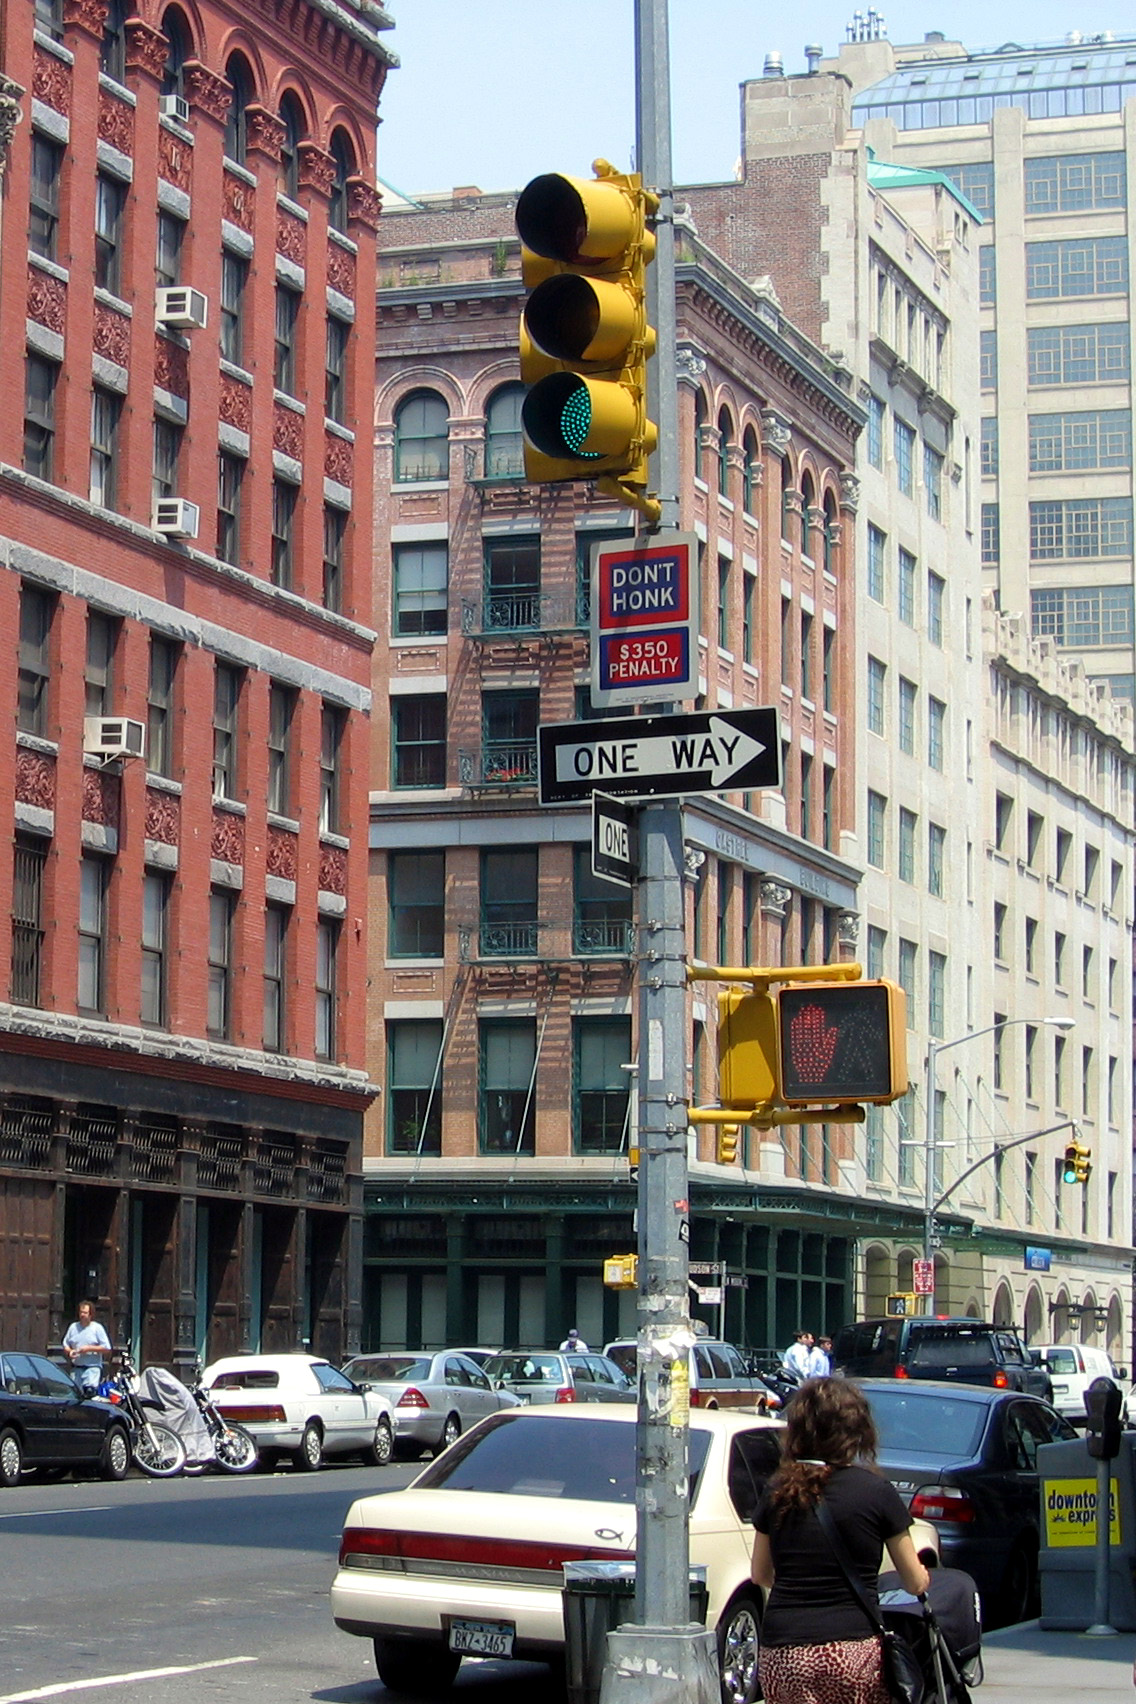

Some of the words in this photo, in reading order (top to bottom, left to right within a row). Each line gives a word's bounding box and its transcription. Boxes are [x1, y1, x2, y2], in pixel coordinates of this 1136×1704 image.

[612, 562, 675, 588] DON'T
[612, 586, 674, 612] HONK
[619, 640, 668, 661] $350
[609, 656, 679, 679] PENALTY
[573, 743, 640, 777] ONE
[671, 735, 741, 769] WAY
[605, 822, 628, 858] ONE
[688, 1264, 710, 1274] UDSON
[1048, 1489, 1115, 1511] downton
[1068, 1508, 1116, 1527] exprs
